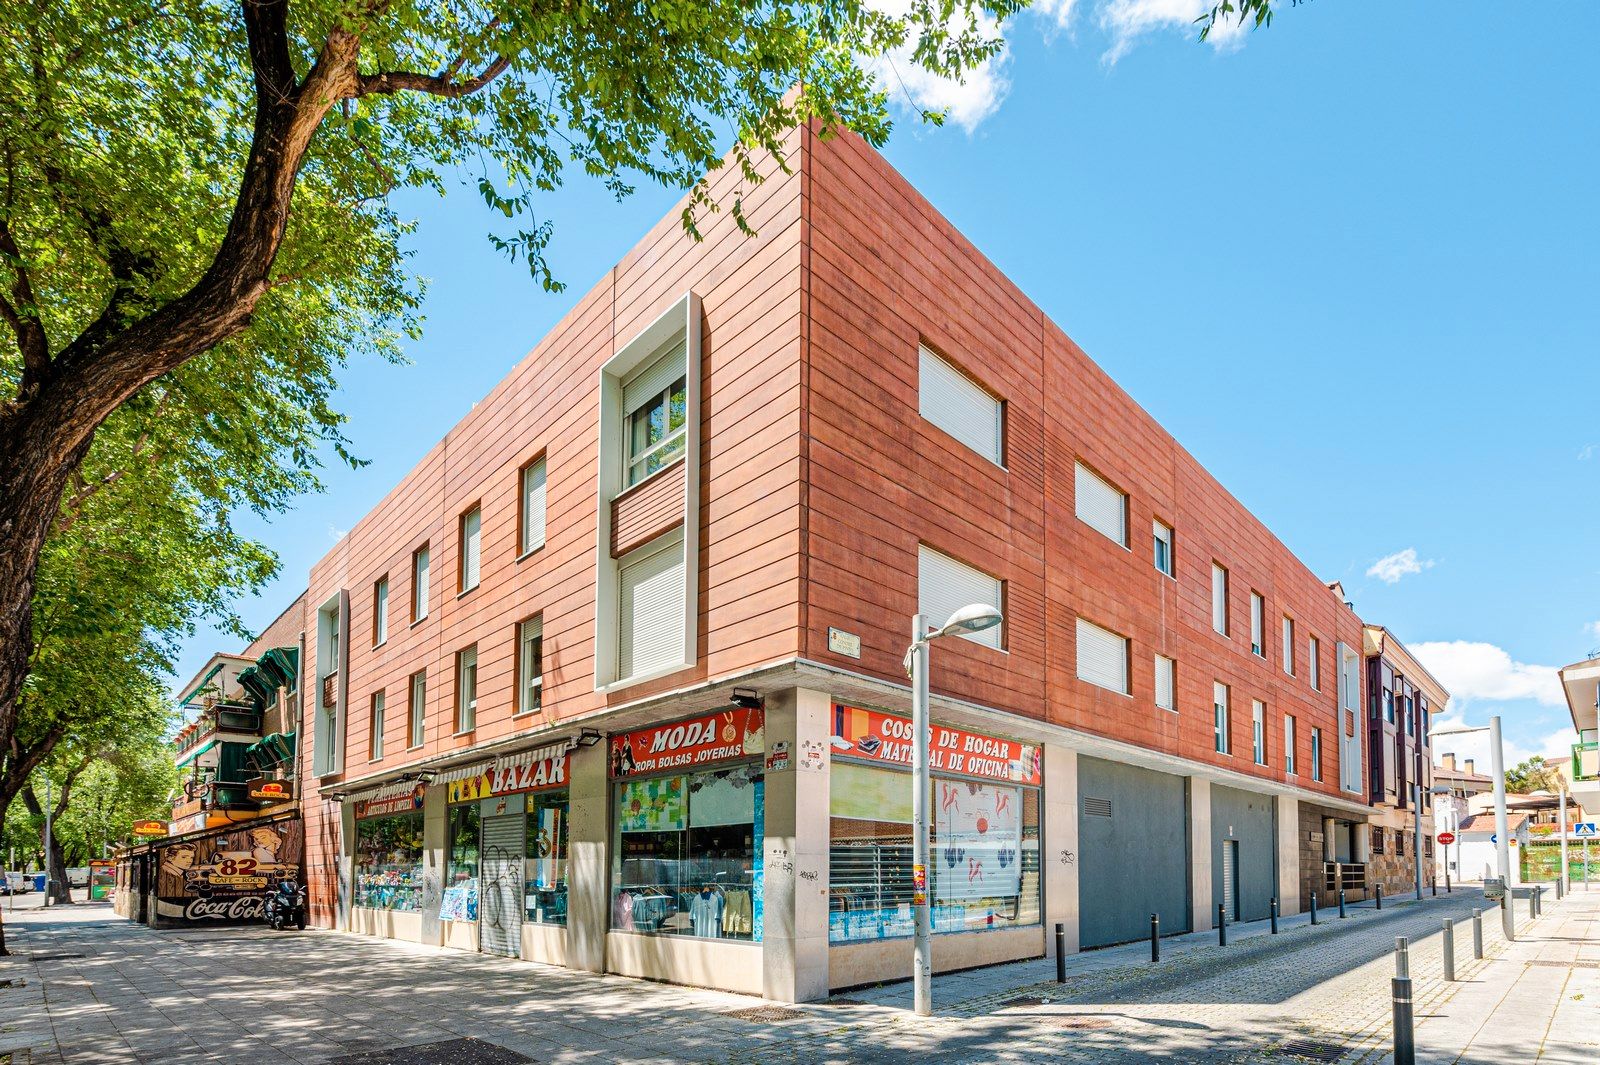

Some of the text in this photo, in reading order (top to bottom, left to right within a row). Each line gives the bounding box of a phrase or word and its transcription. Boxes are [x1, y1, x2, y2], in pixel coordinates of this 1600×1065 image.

[649, 719, 716, 754] MODA
[881, 719, 1009, 759] COSS DE HOGAR
[490, 757, 566, 793] BAZAR
[635, 744, 742, 772] ROPA BOLSAS JOYERIAS
[880, 741, 1009, 778] MATEAL DE OFICINA
[220, 858, 258, 876] 82
[186, 896, 265, 920] Coca-Col
